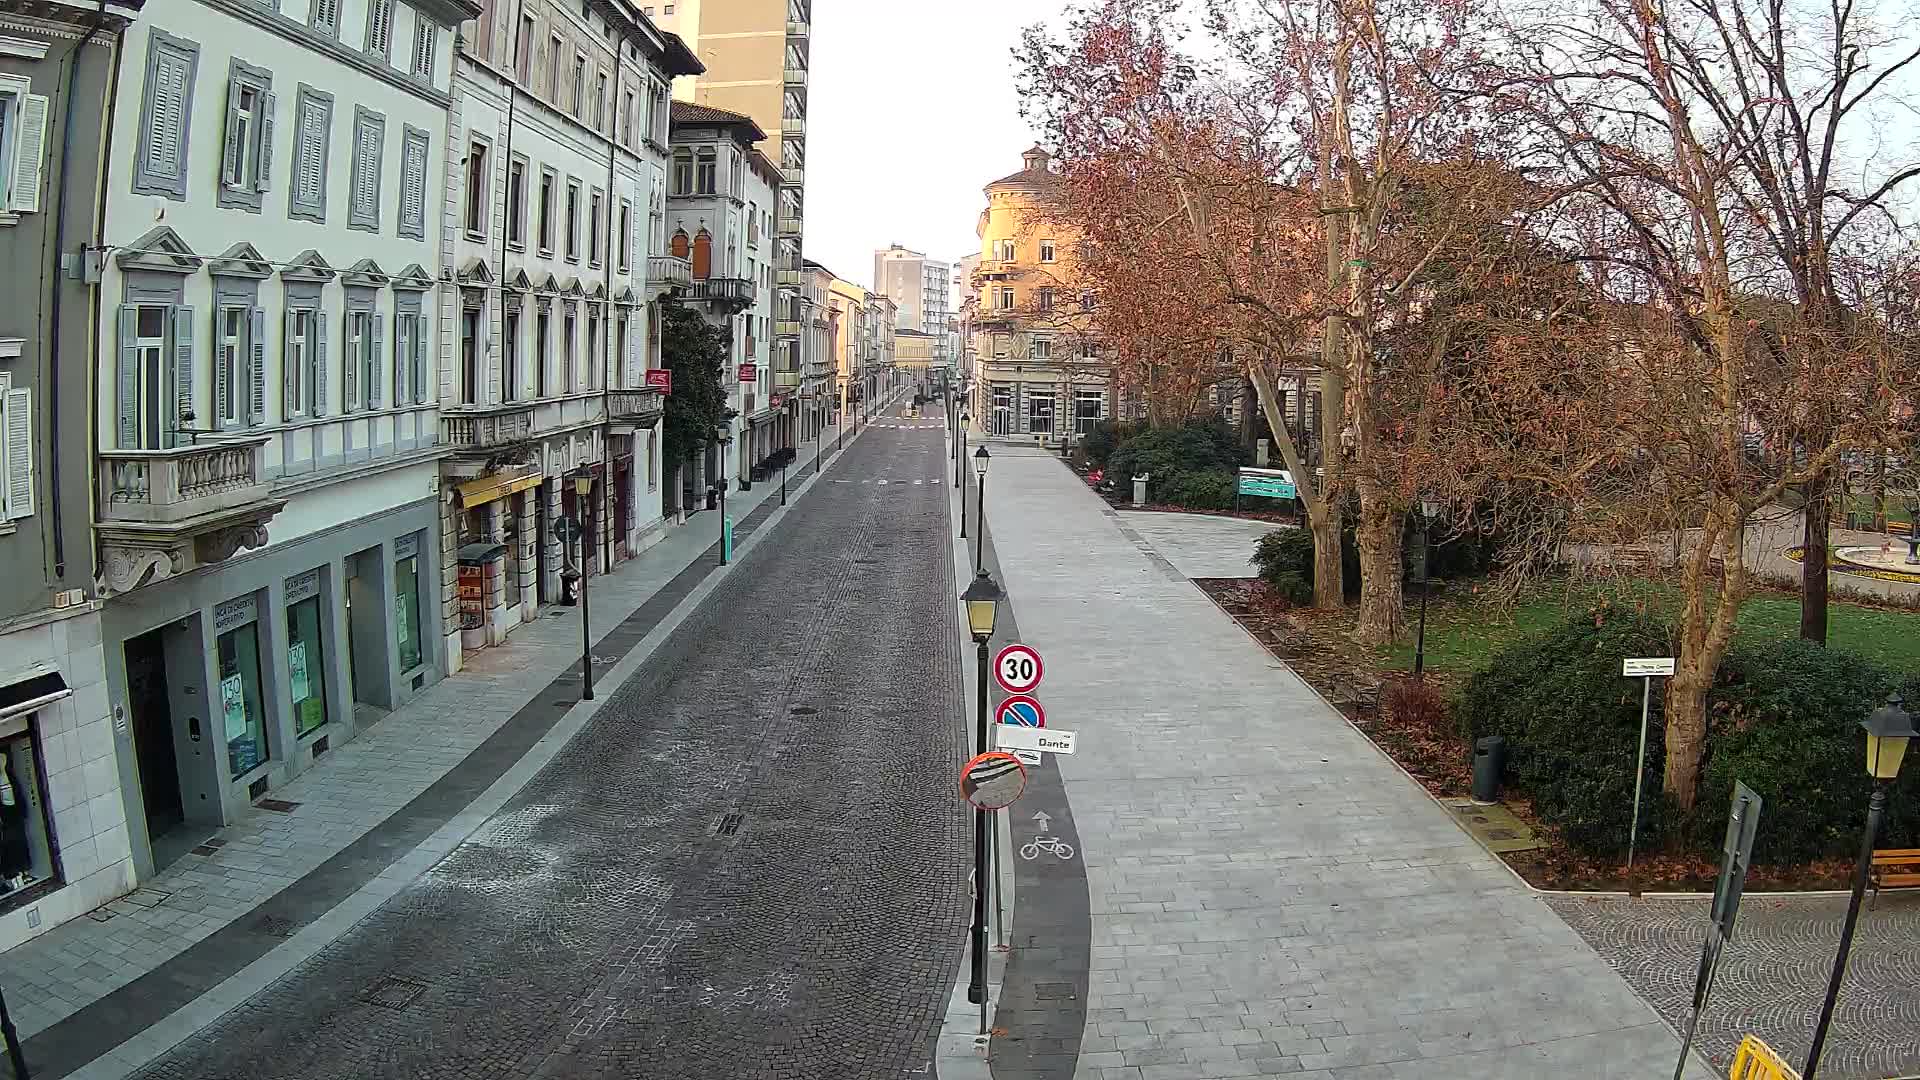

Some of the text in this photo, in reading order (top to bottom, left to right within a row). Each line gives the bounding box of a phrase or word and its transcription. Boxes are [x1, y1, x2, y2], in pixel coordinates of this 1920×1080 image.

[1006, 658, 1033, 680] 30
[223, 677, 241, 700] 130
[1038, 738, 1070, 749] Dante
